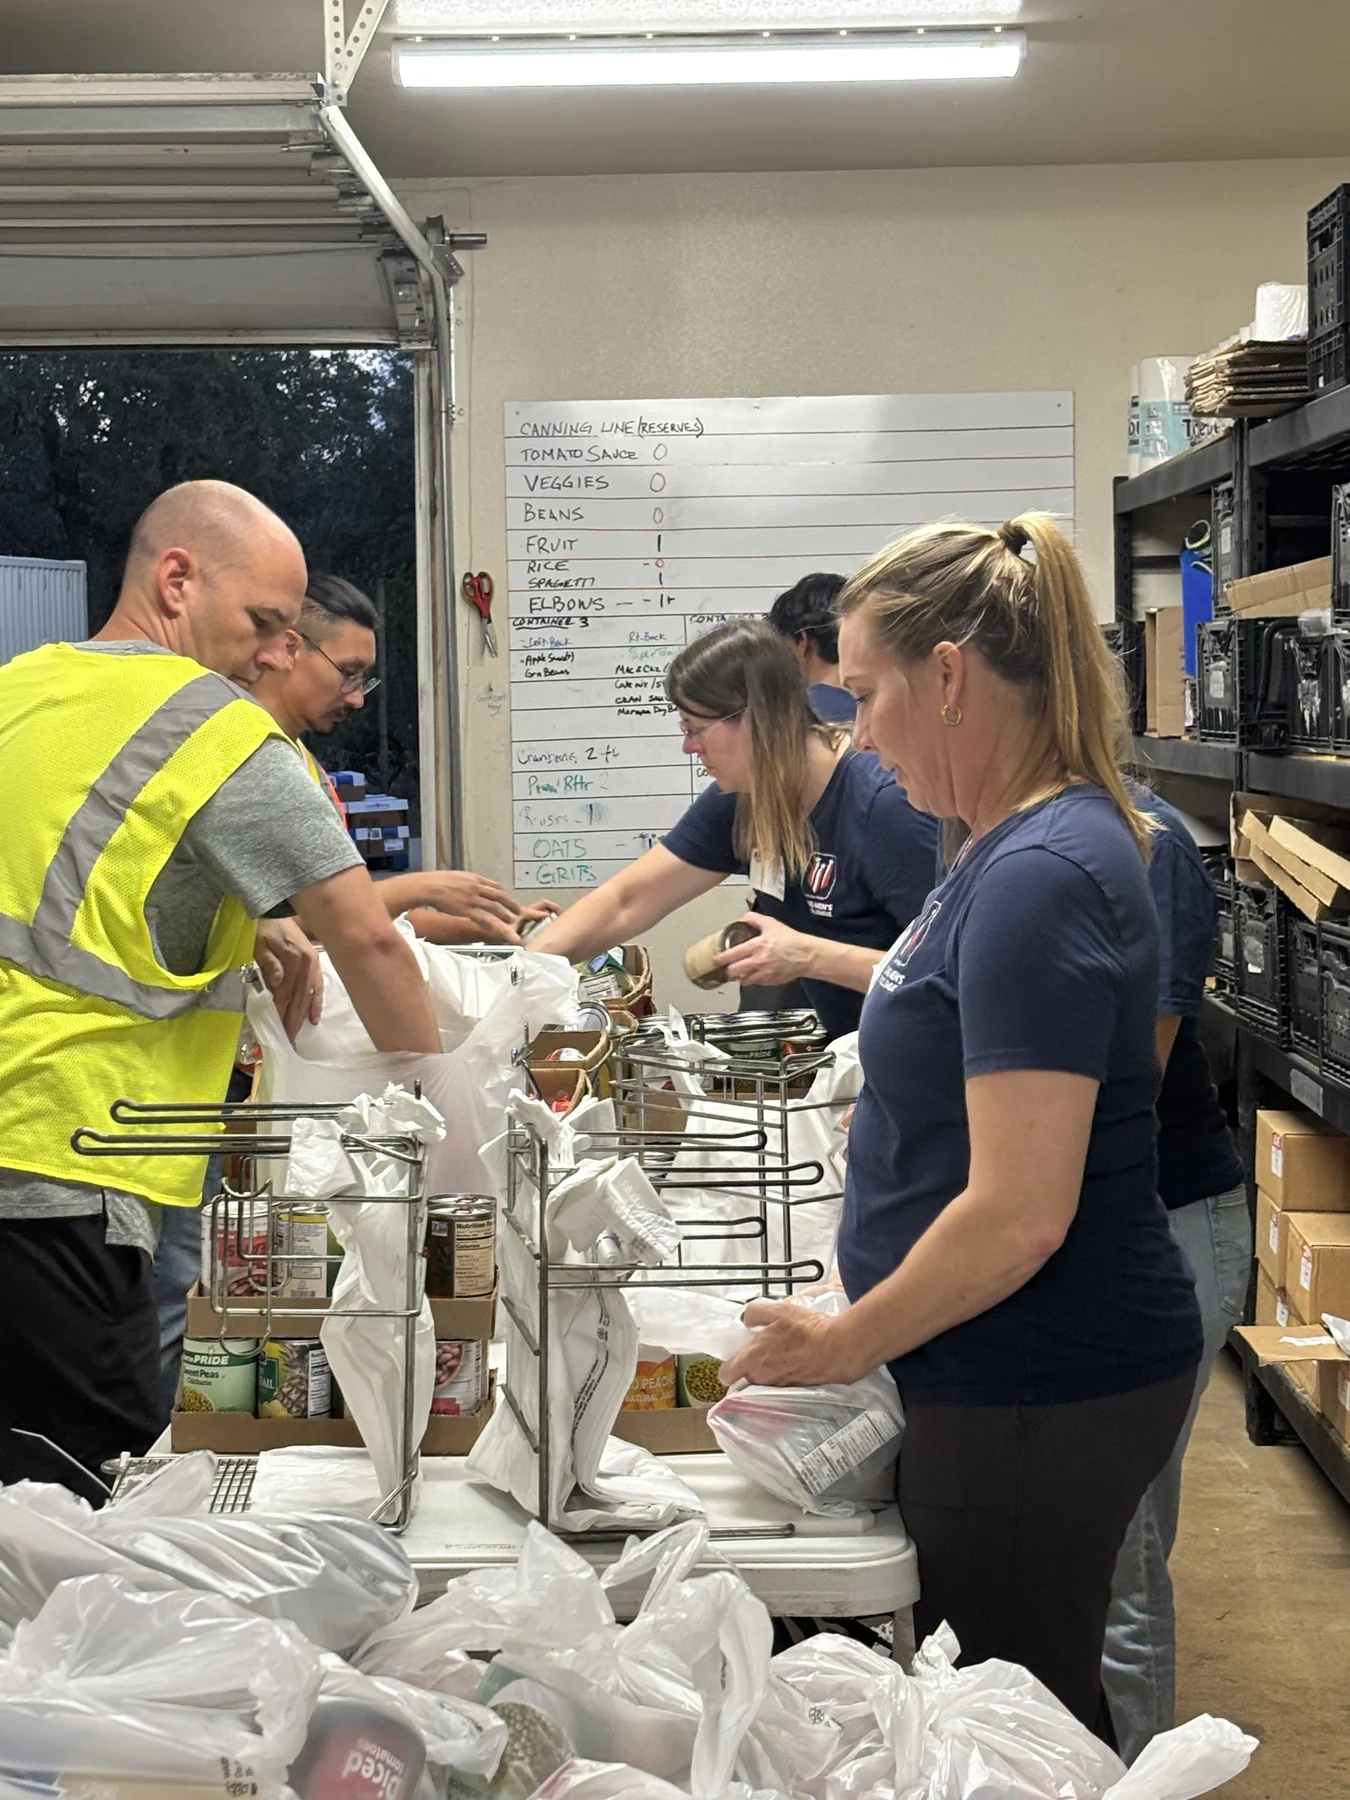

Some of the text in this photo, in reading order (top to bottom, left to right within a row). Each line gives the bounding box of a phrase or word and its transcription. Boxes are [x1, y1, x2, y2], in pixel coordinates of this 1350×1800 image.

[520, 421, 592, 436] CANNING
[601, 420, 634, 434] LINE
[521, 449, 583, 461] TOMATO
[585, 445, 639, 462] SAUCE
[524, 475, 609, 492] VEGGIES
[524, 503, 584, 522] BEANS
[526, 535, 578, 554] FRUIT
[527, 560, 570, 574] RICE
[512, 616, 589, 628] CONTAINER 3
[533, 838, 587, 859] OATS
[193, 1355, 230, 1366] PRIDE
[200, 1369, 220, 1379] Peas
[341, 1750, 402, 1800] Diced
